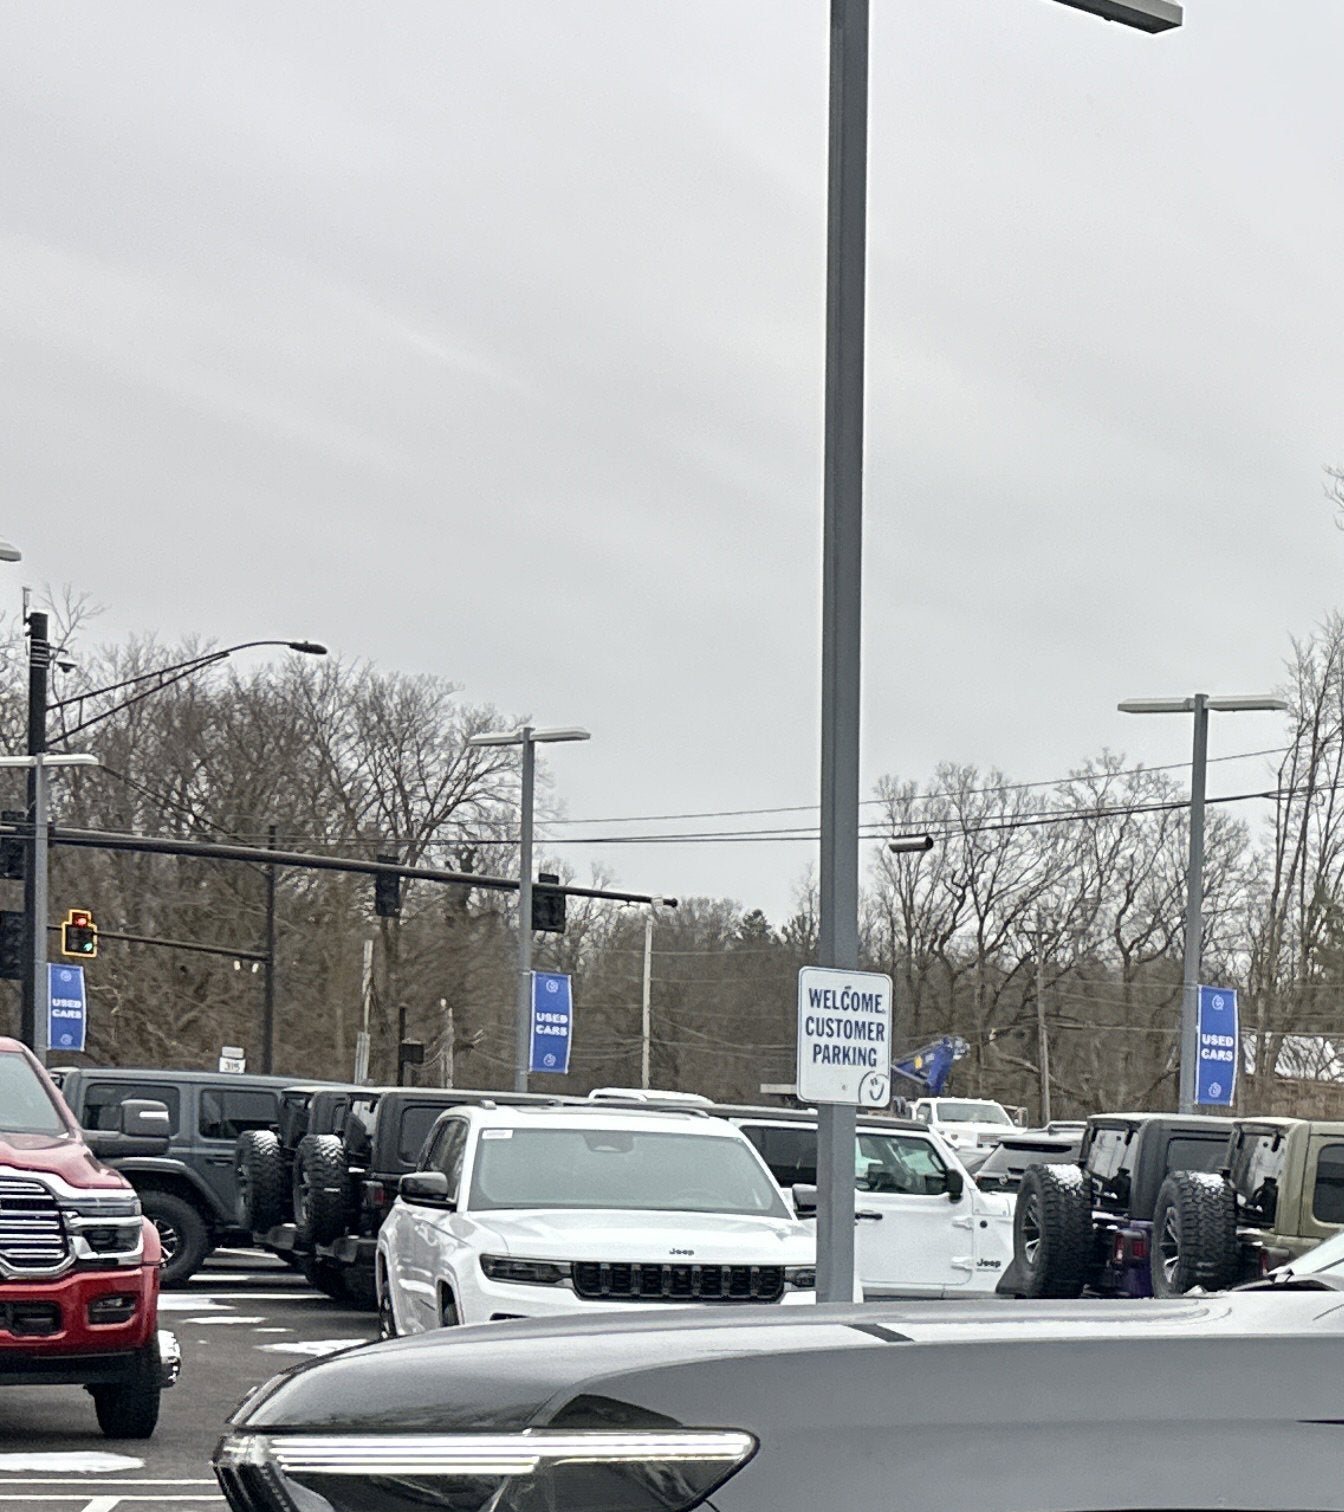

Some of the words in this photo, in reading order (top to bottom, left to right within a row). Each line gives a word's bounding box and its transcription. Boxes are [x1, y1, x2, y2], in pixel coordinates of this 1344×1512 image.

[52, 998, 82, 1008] USED
[808, 987, 883, 1014] WELCOME
[52, 1009, 82, 1019] CARS
[536, 1012, 568, 1024] USED
[535, 1025, 568, 1036] CARS
[805, 1016, 885, 1042] CUSTOMER
[1202, 1034, 1234, 1047] USED
[812, 1043, 877, 1067] PARKING
[1201, 1048, 1233, 1062] CARS
[976, 1258, 1001, 1268] Jeep
